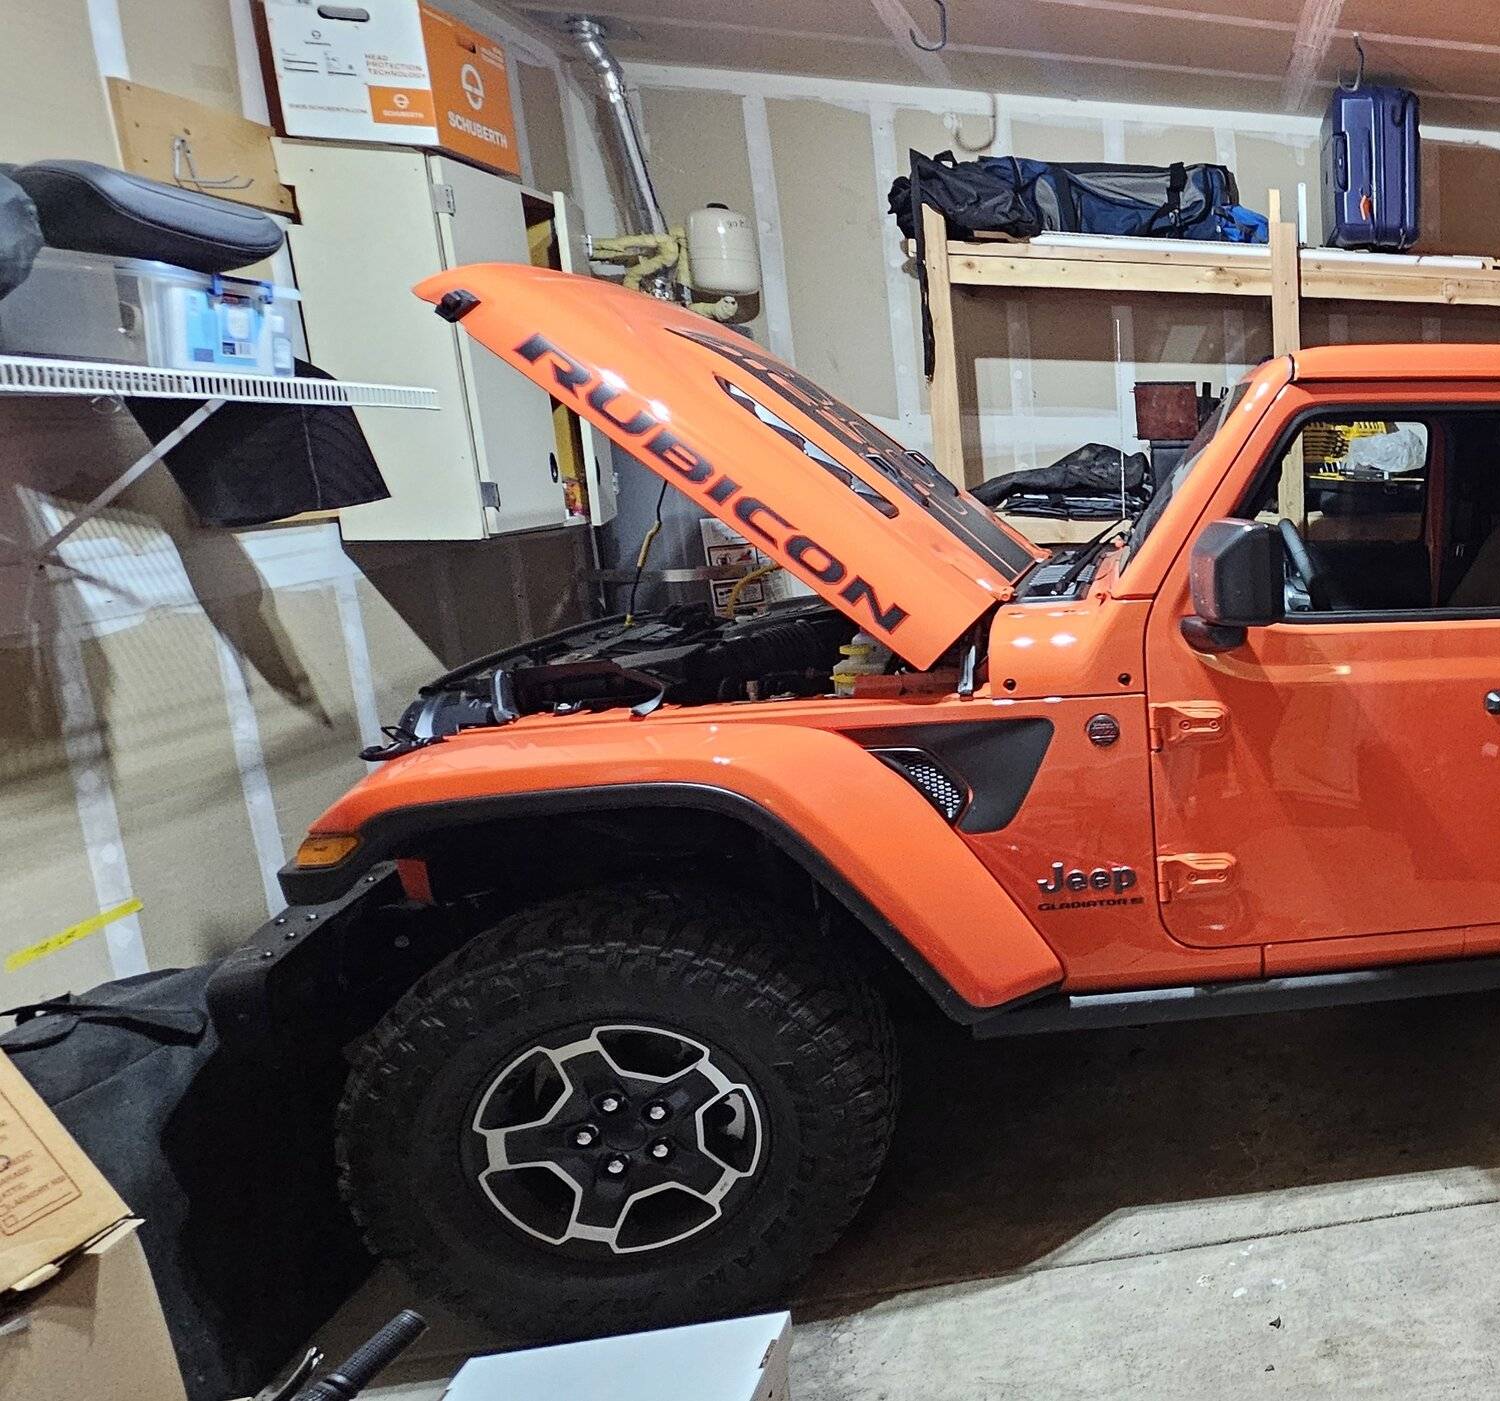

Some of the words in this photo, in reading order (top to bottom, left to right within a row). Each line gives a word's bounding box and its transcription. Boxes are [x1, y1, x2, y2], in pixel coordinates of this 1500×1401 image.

[447, 110, 508, 149] SCHUBERTH
[513, 332, 911, 635] RUBICON
[1036, 860, 1137, 895] Jeep
[1037, 897, 1128, 912] GLADIATOR
